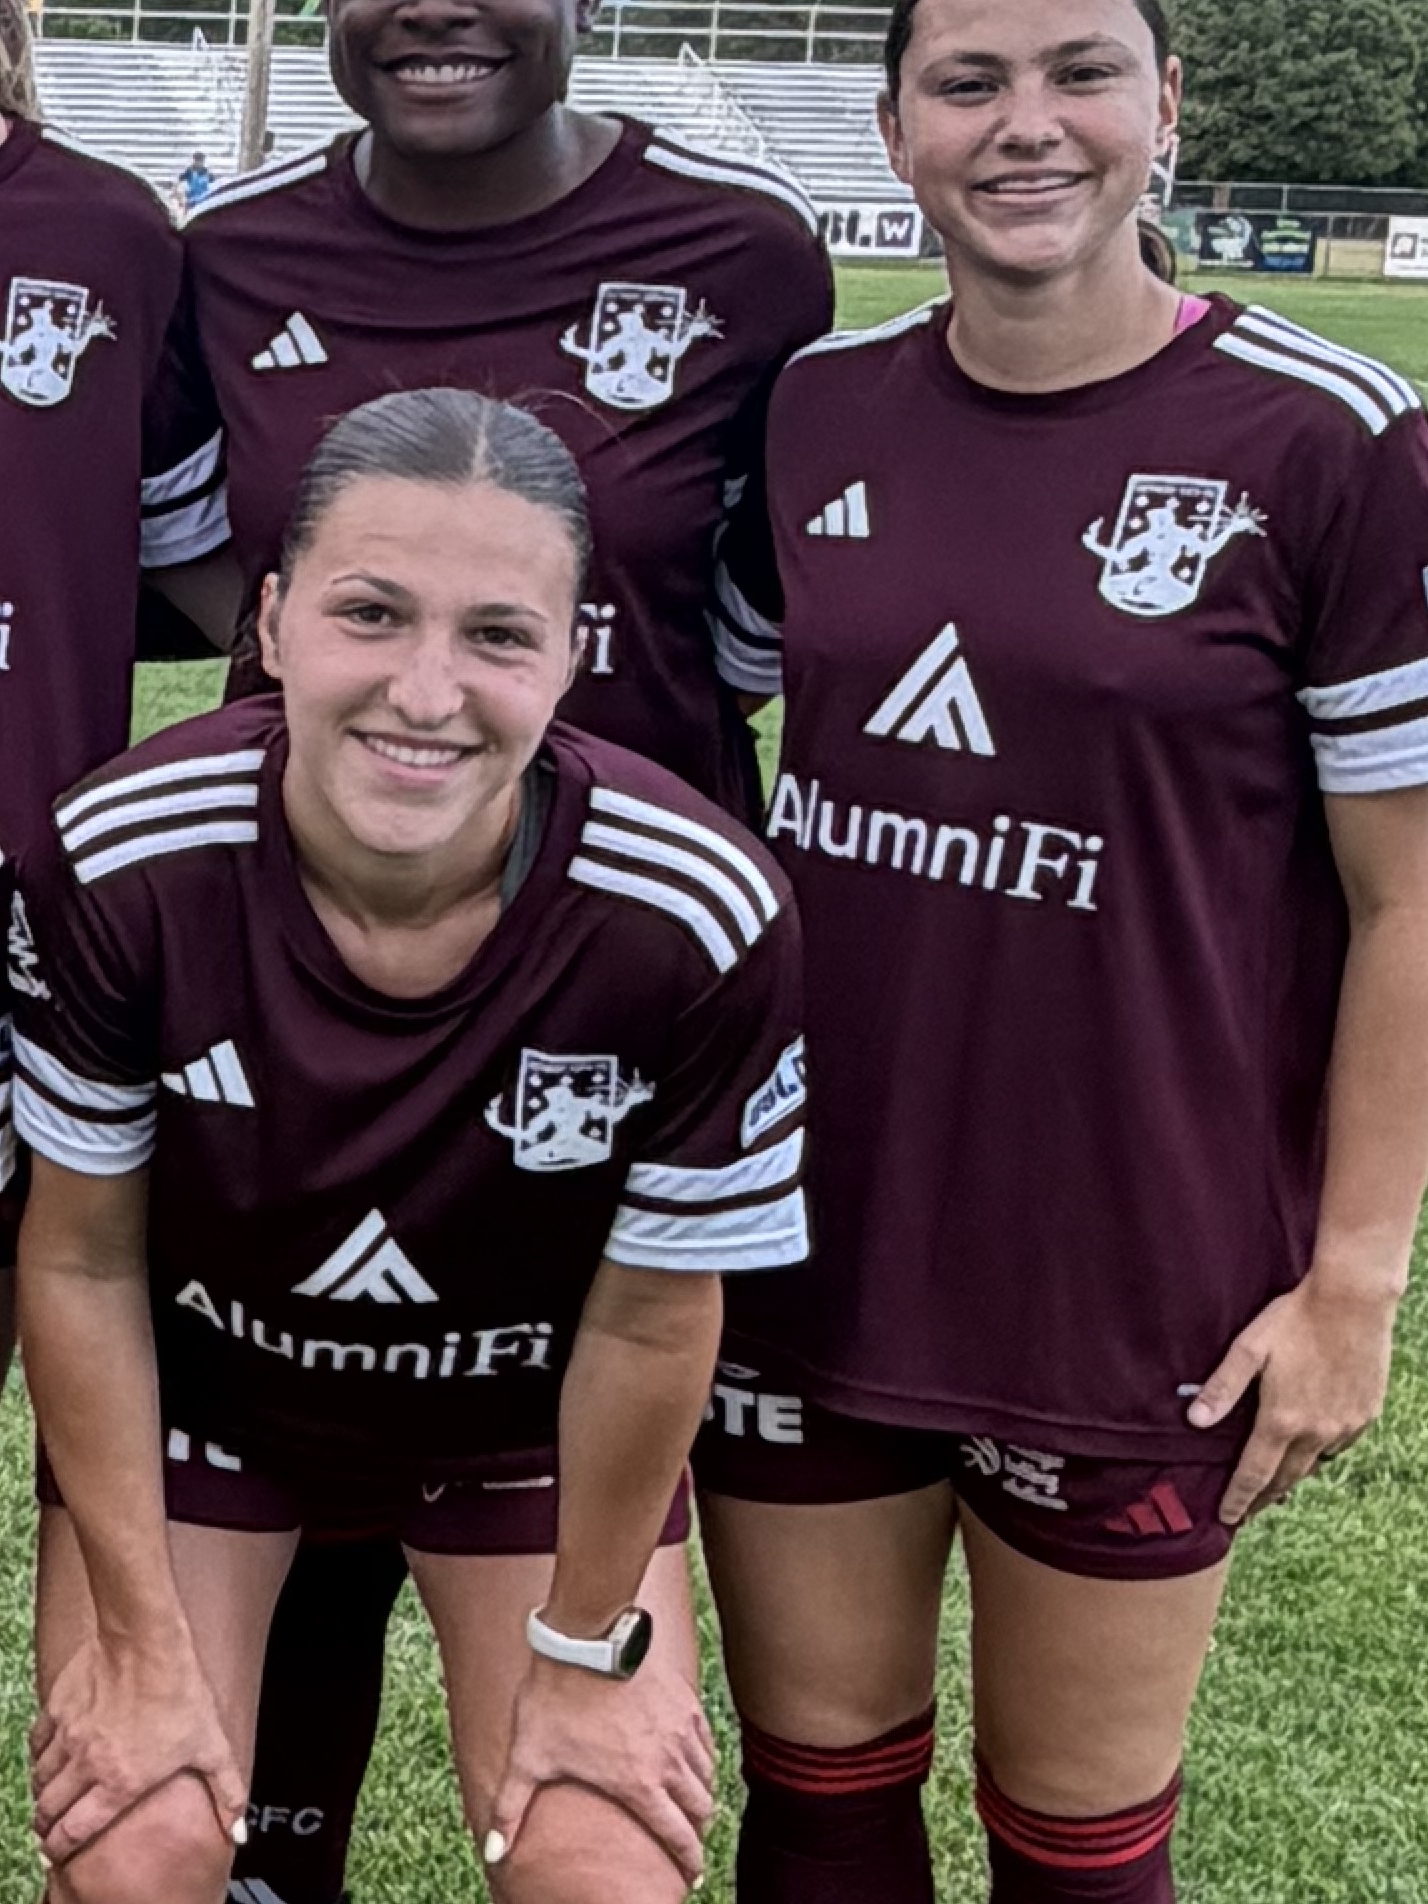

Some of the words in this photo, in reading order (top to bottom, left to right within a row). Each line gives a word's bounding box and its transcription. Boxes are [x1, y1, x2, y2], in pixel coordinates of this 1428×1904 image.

[766, 773, 1104, 910] AlumniFi
[176, 1280, 555, 1378] AlumniFi
[705, 1385, 804, 1444] TE
[243, 1802, 326, 1836] CFC
